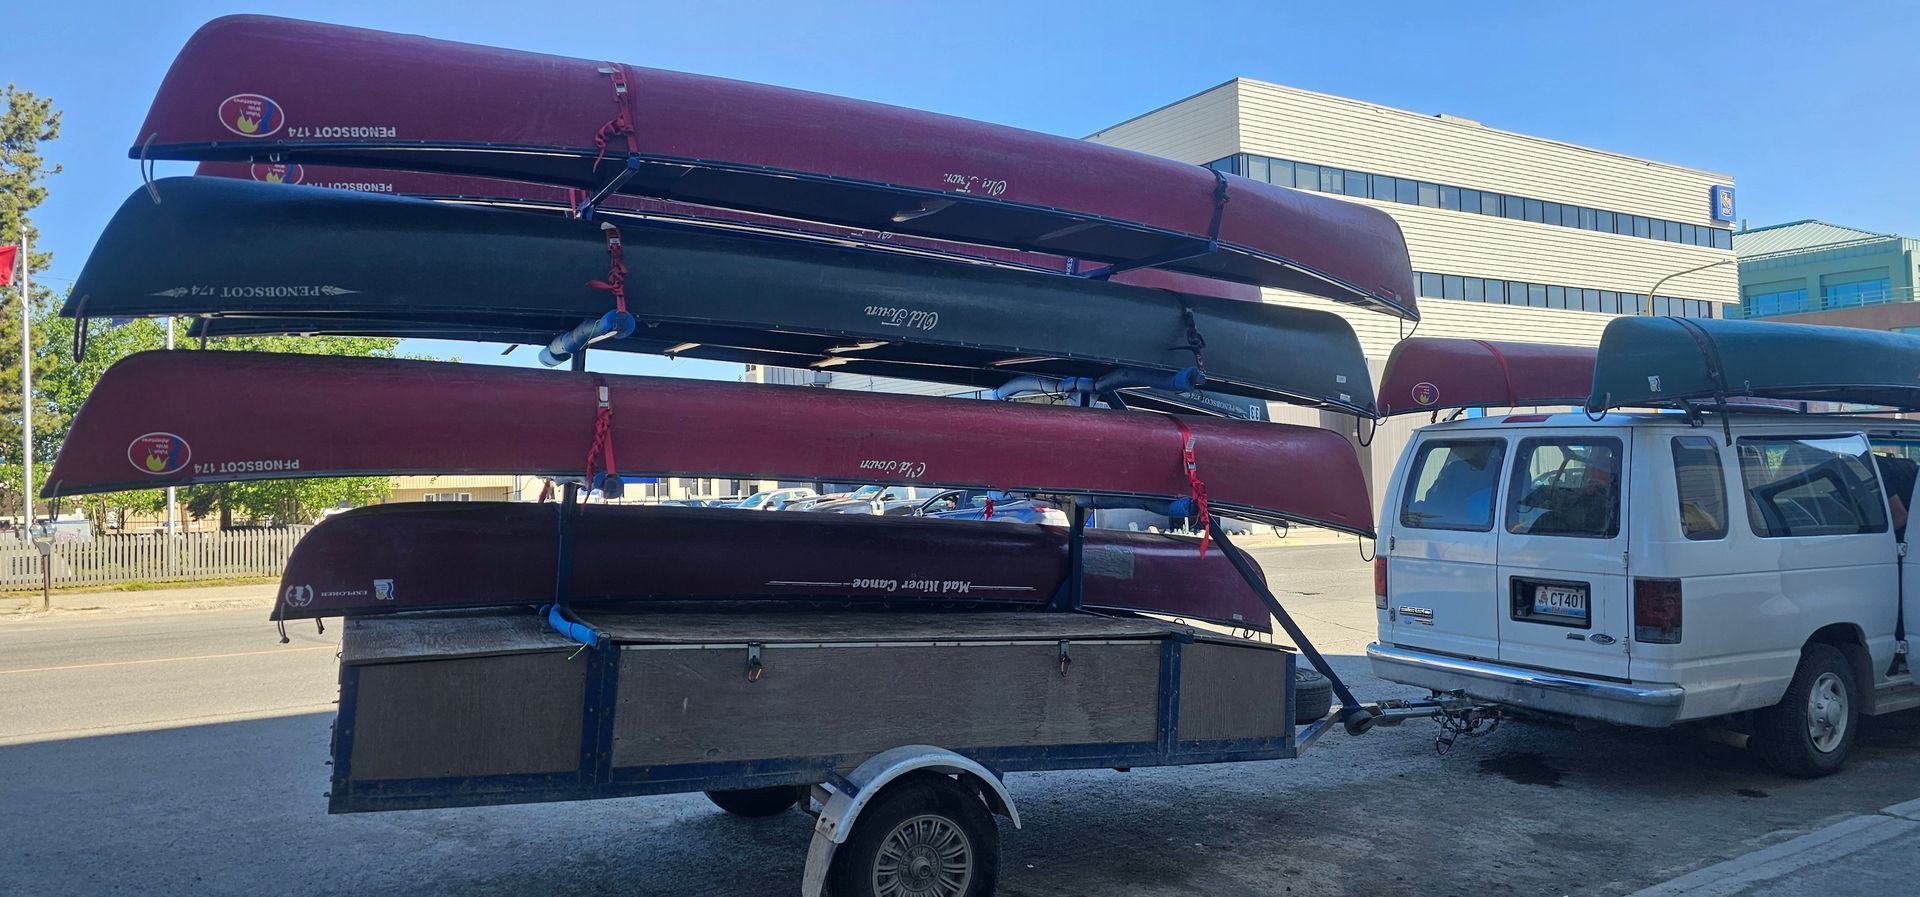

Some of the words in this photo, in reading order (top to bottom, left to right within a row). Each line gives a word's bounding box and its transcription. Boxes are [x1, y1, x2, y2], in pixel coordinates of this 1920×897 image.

[288, 126, 310, 137] 174
[314, 126, 396, 138] PENOBSCOT
[191, 284, 216, 296] 174
[220, 285, 320, 298] PENOBSCOT
[863, 305, 908, 327] Town
[906, 310, 939, 331] Old
[1202, 396, 1235, 412] PENOBSCOT
[194, 463, 215, 474] 174
[852, 578, 898, 592] Canoe
[901, 579, 940, 593] River
[942, 580, 971, 593] Mad
[1550, 592, 1584, 609] CT401
